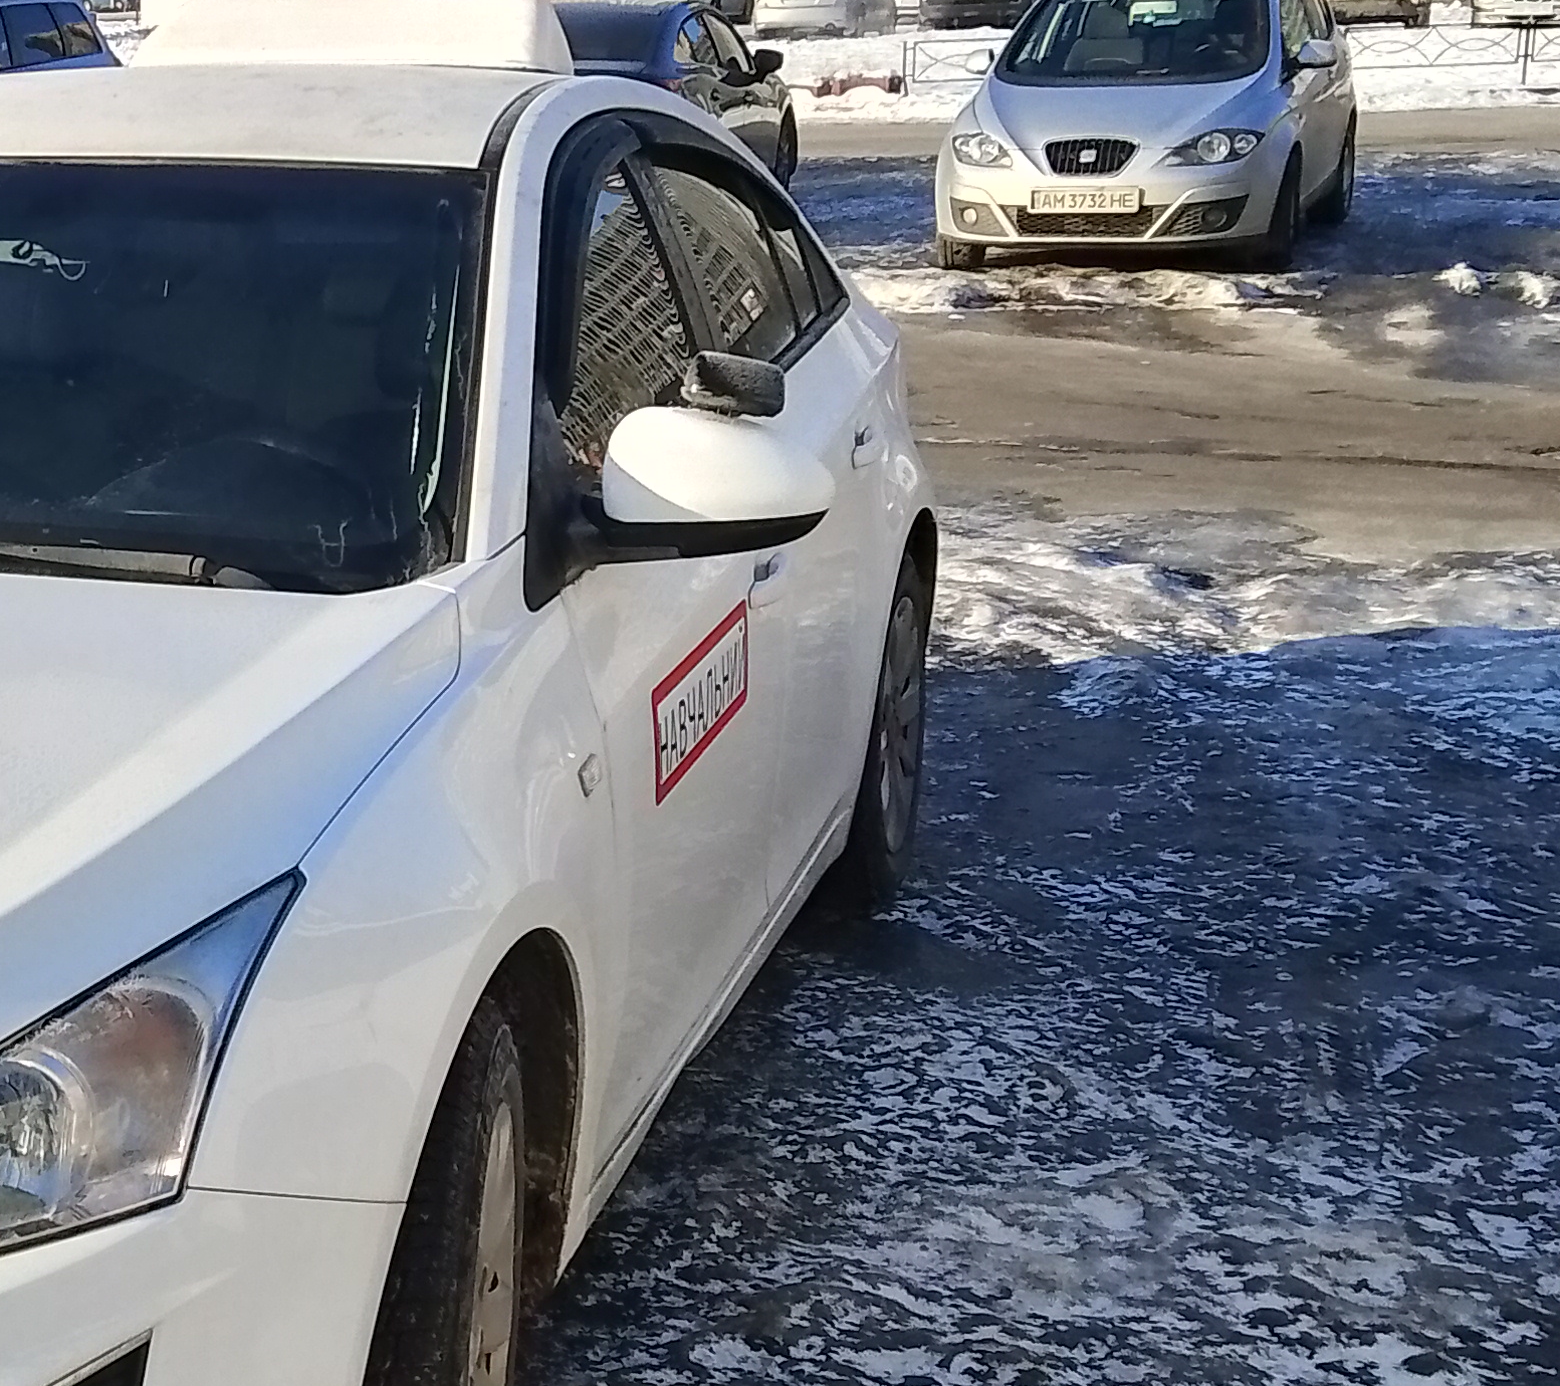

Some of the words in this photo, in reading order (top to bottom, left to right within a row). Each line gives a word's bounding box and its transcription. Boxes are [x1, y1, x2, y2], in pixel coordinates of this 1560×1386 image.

[1042, 194, 1065, 208] AM
[1068, 193, 1107, 208] 3732
[1110, 193, 1134, 208] HE
